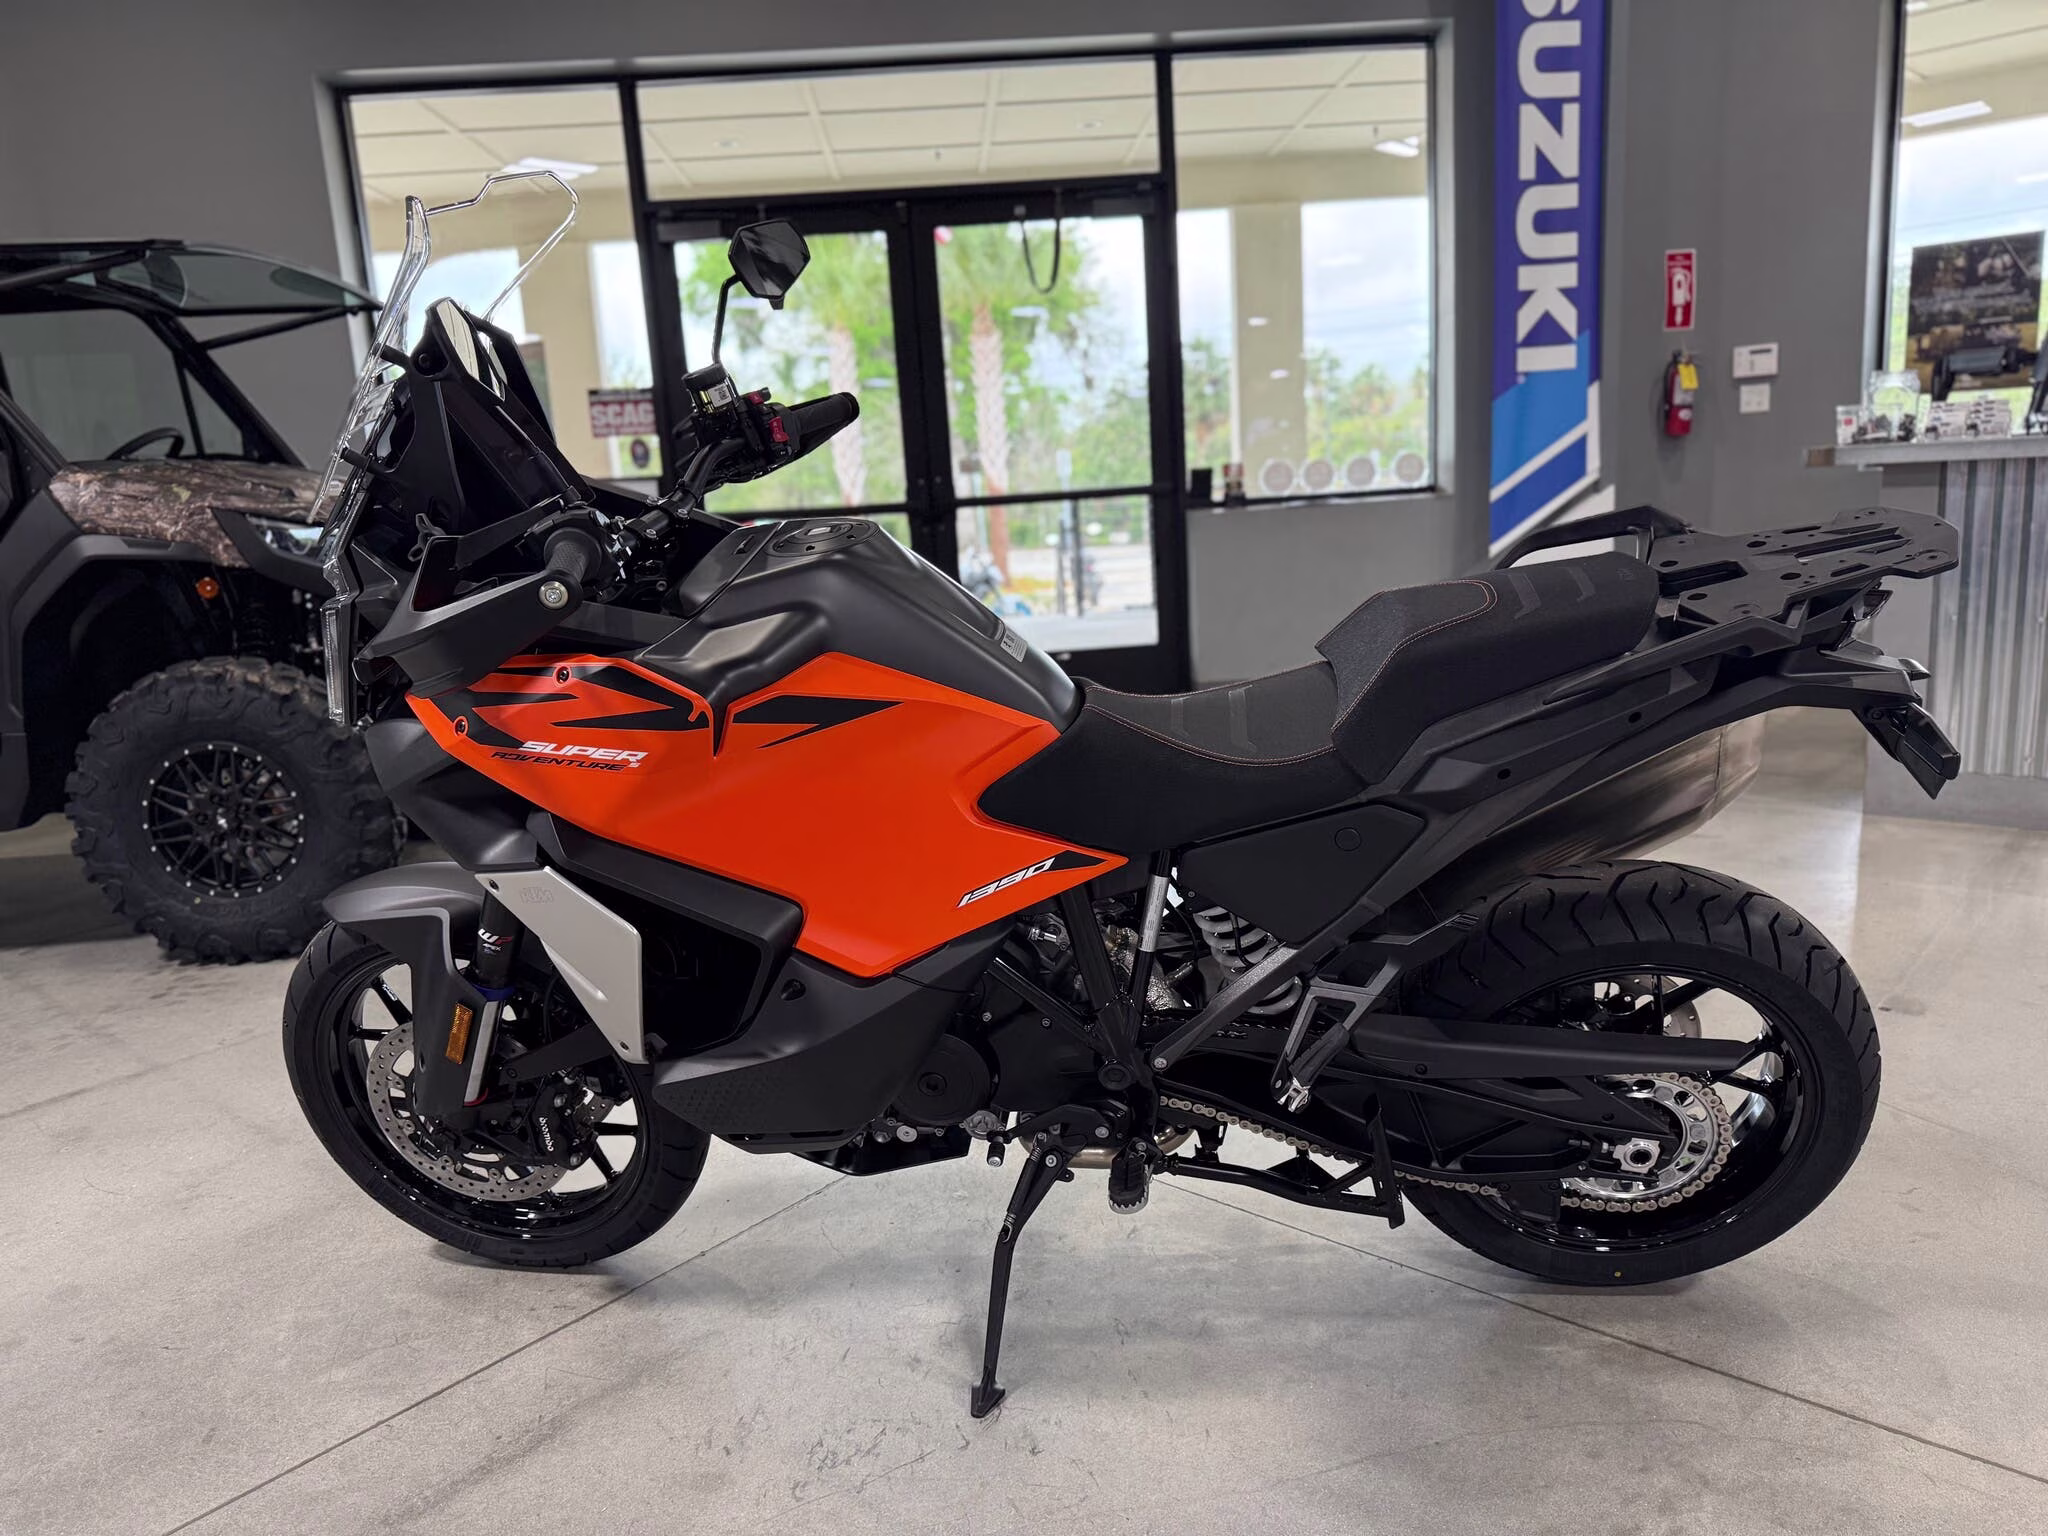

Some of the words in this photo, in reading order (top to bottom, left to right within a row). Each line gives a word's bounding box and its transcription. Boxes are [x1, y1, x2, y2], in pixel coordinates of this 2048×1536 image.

[1516, 0, 1582, 373] UZUKI
[491, 751, 627, 771] ADVENTURE
[518, 740, 649, 762] SUPER
[956, 857, 1056, 908] 1390
[478, 928, 512, 944] WP
[539, 1117, 554, 1151] brembo
